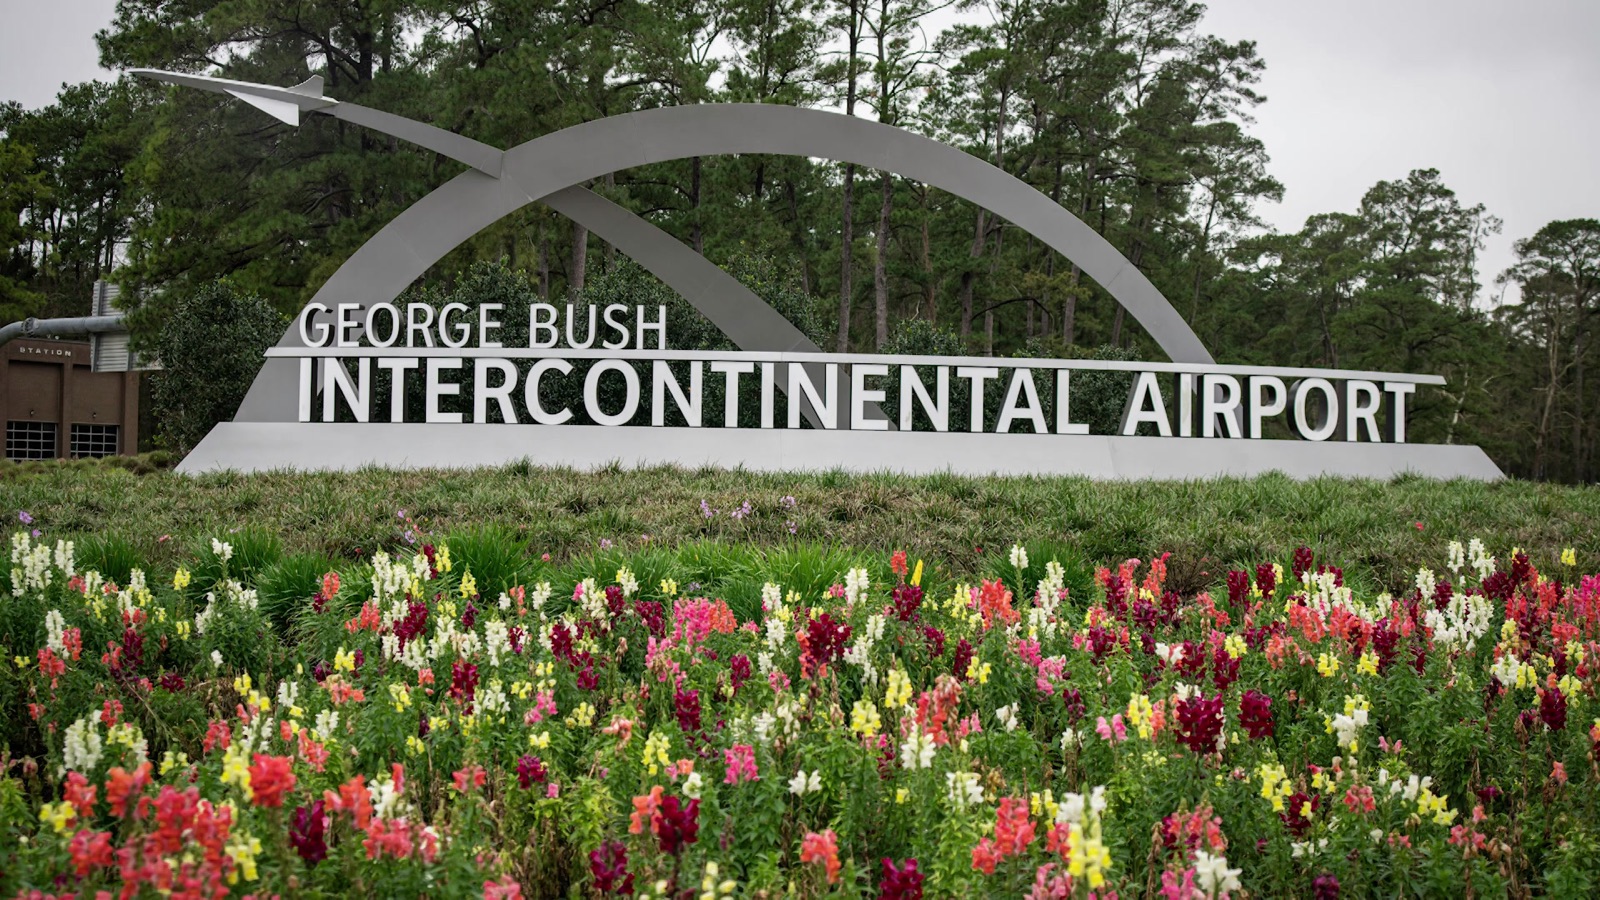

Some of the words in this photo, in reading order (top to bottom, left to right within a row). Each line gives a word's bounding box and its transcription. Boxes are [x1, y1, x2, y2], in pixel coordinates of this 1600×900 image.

[299, 303, 503, 348] GEORGE
[529, 303, 667, 350] BUSH
[20, 346, 72, 357] STATION
[298, 357, 1090, 434] INTERCONTINENTAL
[1121, 371, 1416, 443] AIRPORT
